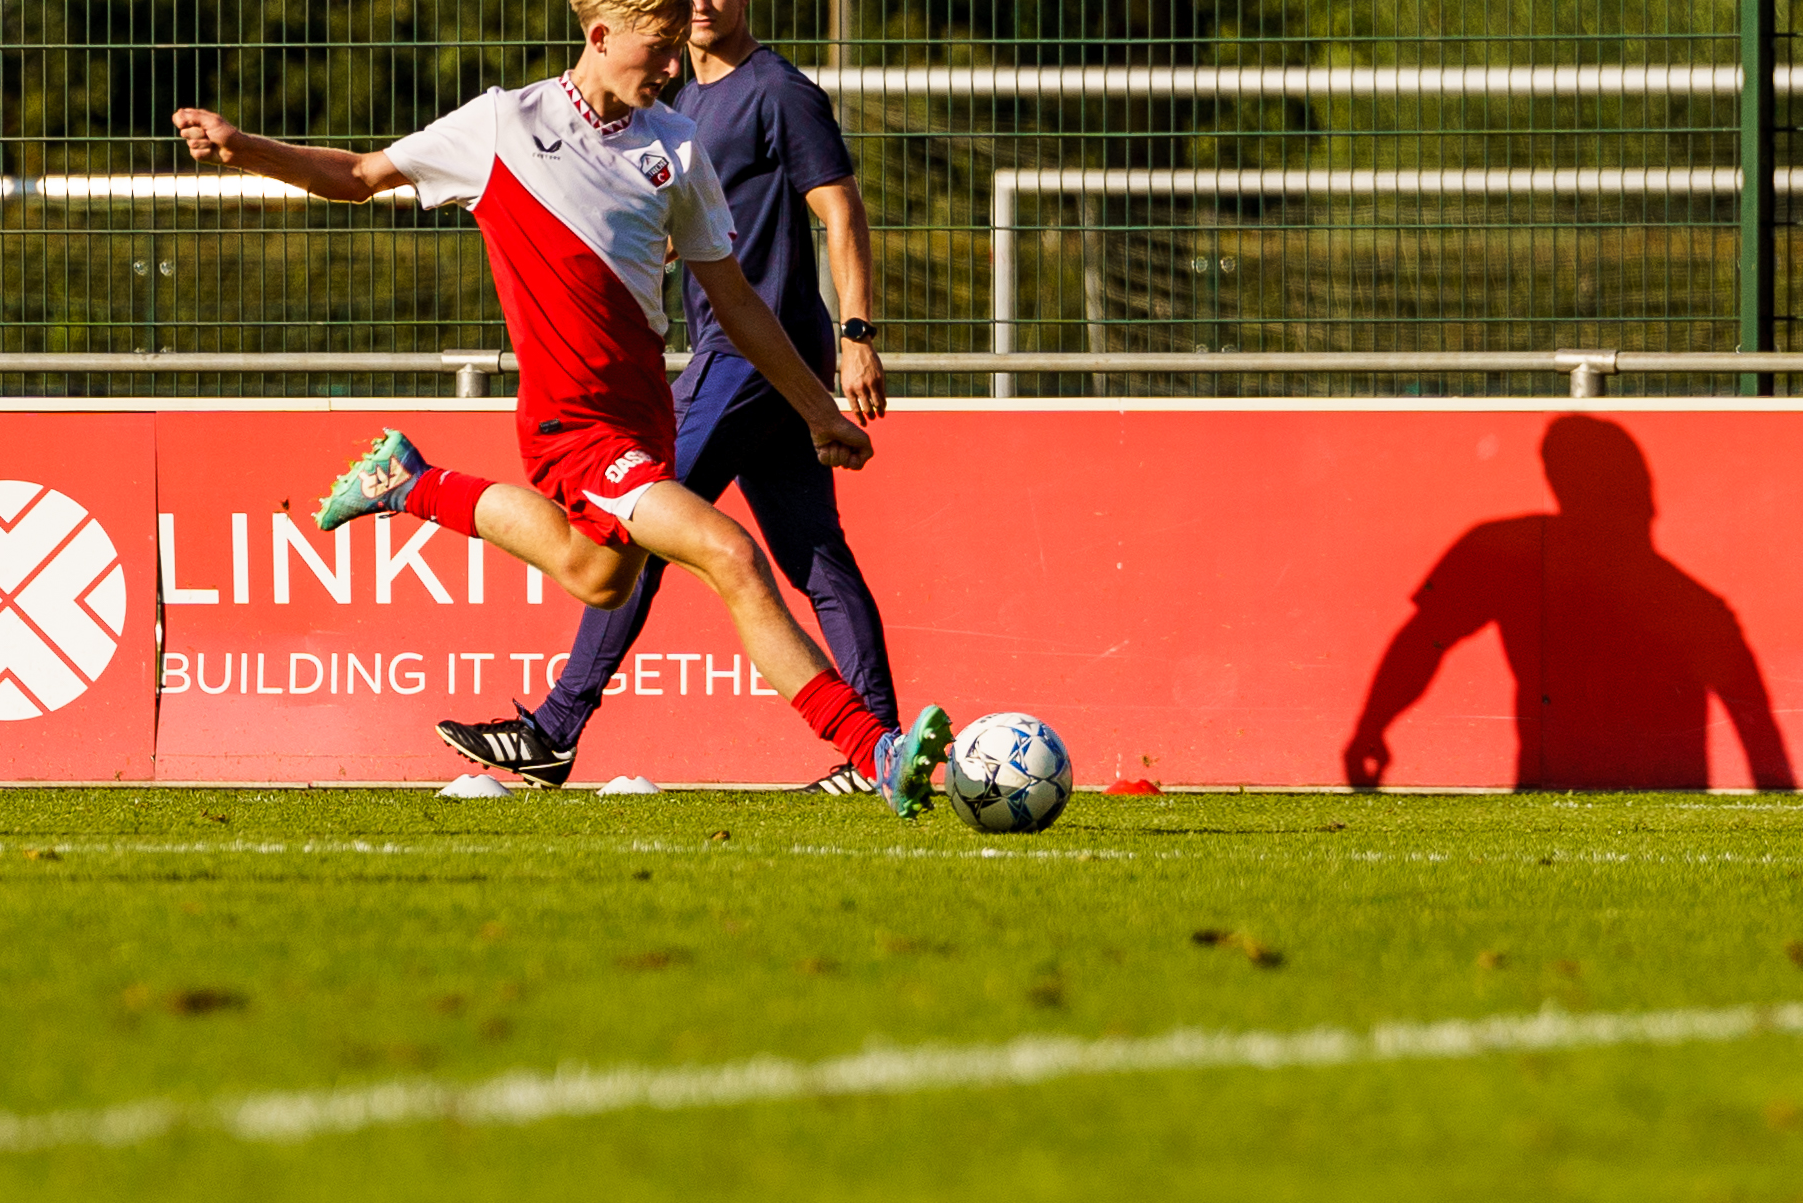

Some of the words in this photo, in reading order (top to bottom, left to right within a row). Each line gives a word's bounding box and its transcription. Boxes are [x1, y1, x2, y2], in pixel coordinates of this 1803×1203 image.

[158, 512, 543, 605] LINKI
[160, 652, 426, 695] BUILDING
[448, 652, 495, 695] IT
[509, 652, 779, 696] TETHE
